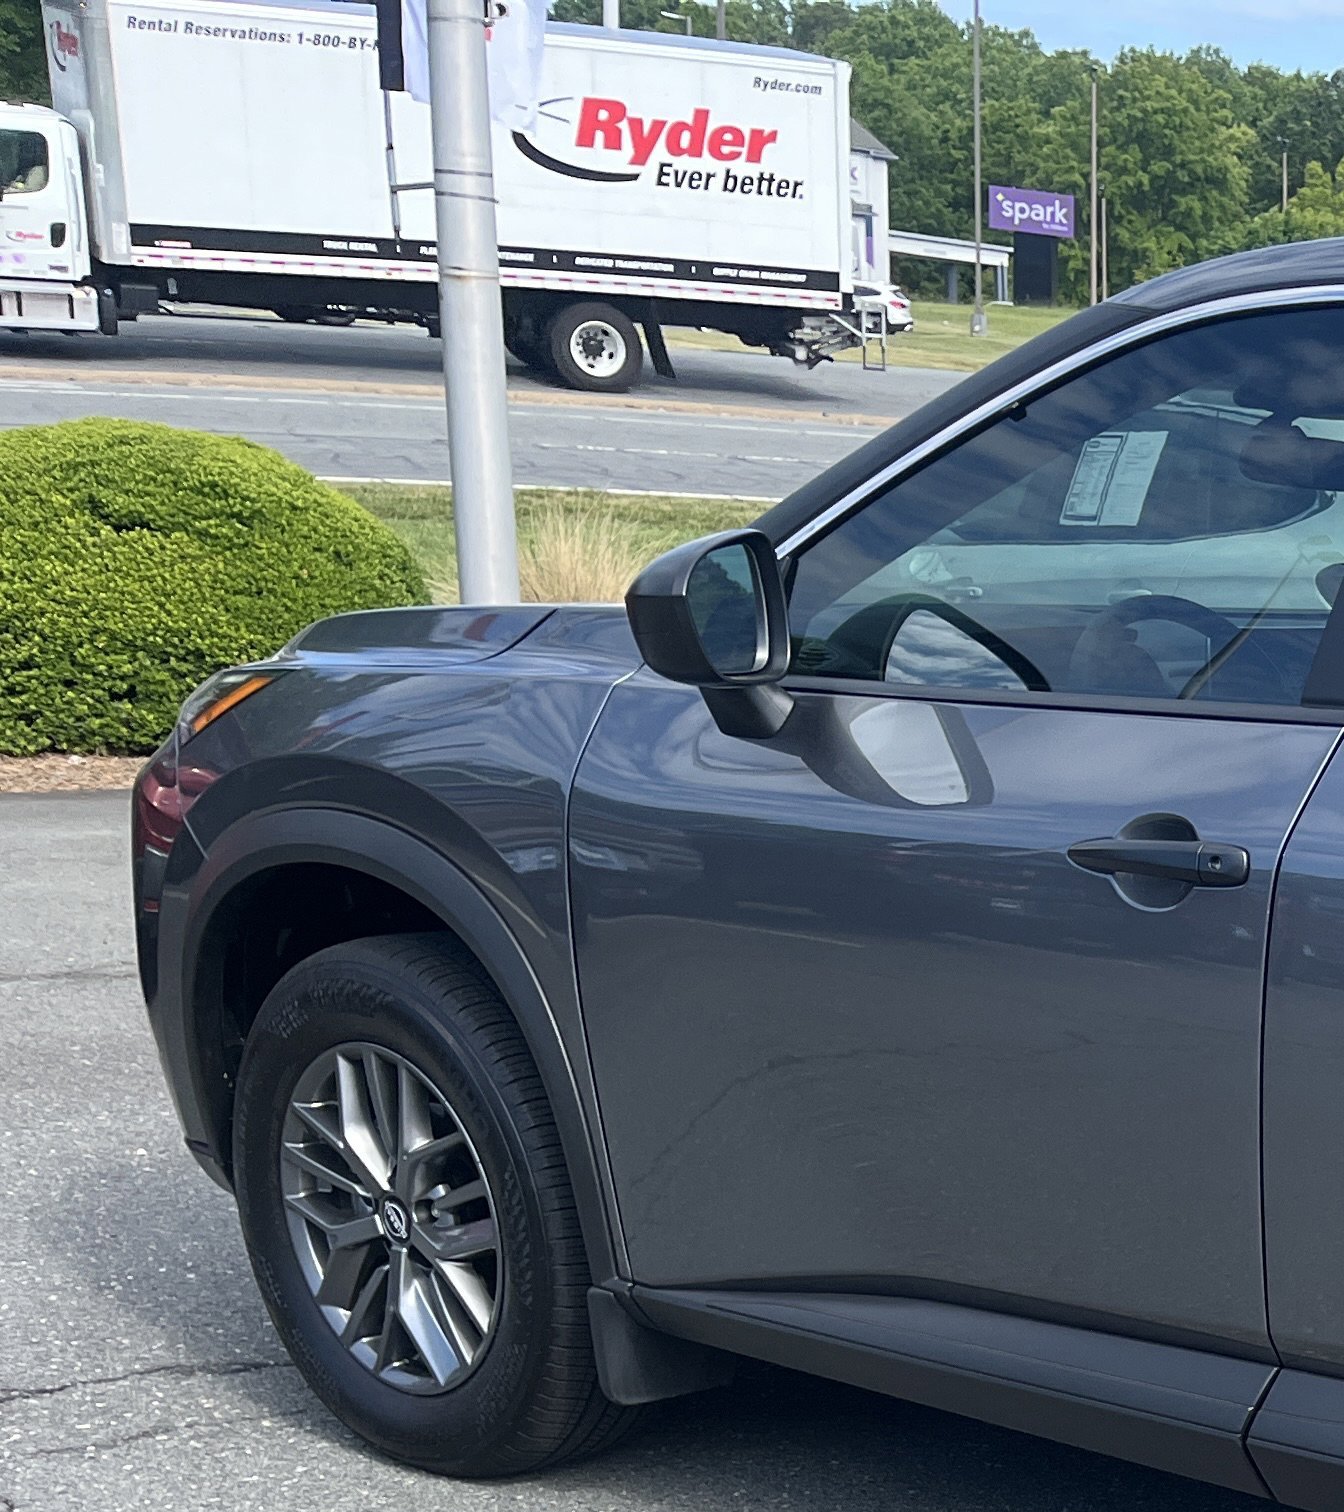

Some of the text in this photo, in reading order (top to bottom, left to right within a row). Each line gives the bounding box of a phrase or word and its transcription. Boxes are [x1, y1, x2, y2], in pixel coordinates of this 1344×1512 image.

[127, 16, 178, 33] Rental
[184, 21, 291, 44] Reservations:
[752, 76, 822, 95] Ryder.com
[575, 96, 778, 166] Ryder
[655, 162, 804, 199] Ever better.
[1001, 199, 1068, 225] spark
